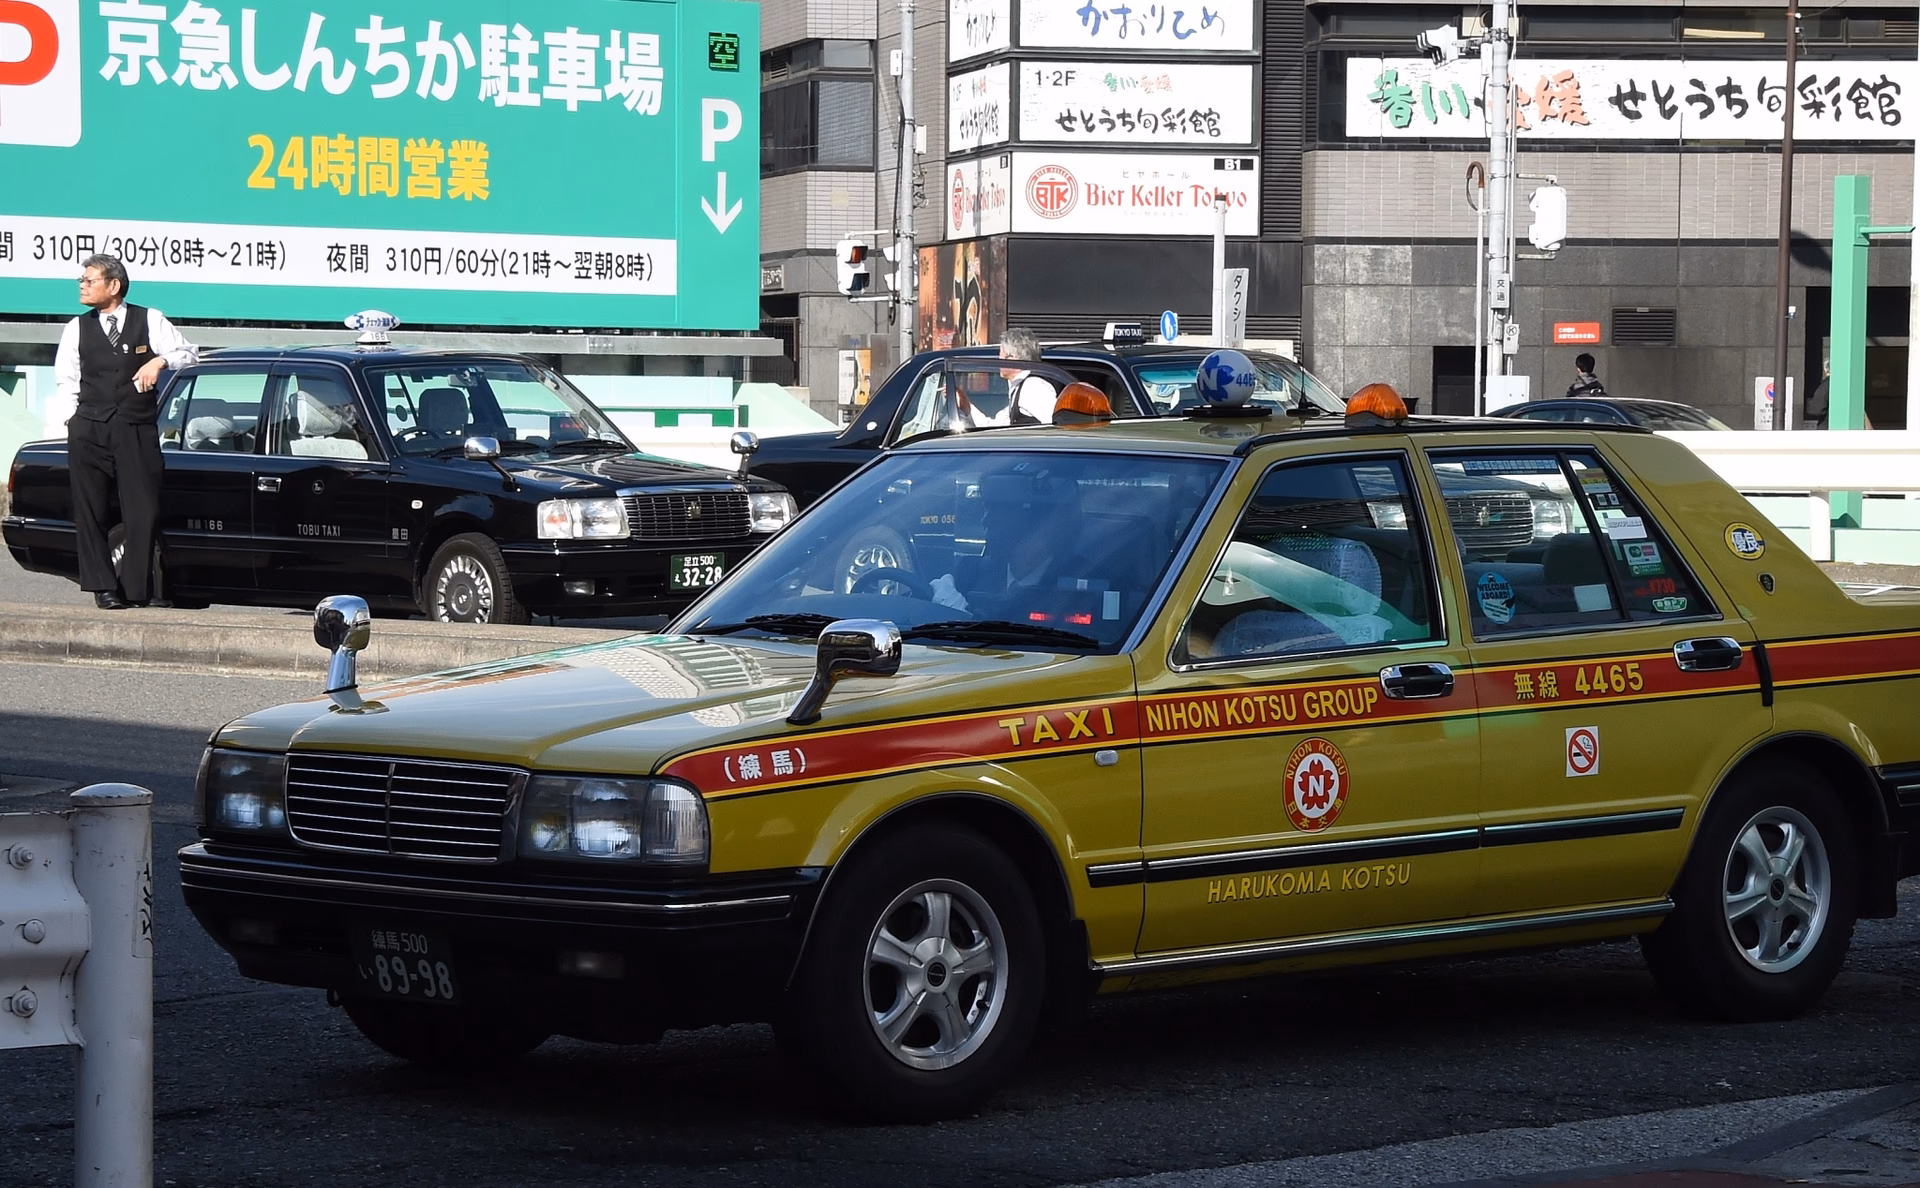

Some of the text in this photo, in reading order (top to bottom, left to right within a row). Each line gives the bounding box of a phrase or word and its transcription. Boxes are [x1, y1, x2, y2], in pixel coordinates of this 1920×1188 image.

[1077, 0, 1225, 40] かおりひめ
[99, 0, 664, 116] 京急しんちか駐車場
[709, 32, 739, 69] 空
[1608, 74, 1902, 126] せとうち旬彩館
[701, 97, 742, 162] P
[1055, 107, 1222, 137] せとうち旬彩館
[248, 133, 490, 201] 24時間営業
[1224, 159, 1241, 171] B1
[1036, 181, 1069, 210] BTK
[1085, 182, 1125, 207] Bier
[1131, 184, 1184, 208] Keller
[327, 243, 369, 274] 夜間
[1233, 275, 1243, 338] タクシー
[1114, 328, 1142, 337] TOKYO TAXI
[204, 519, 224, 531] 166
[297, 524, 341, 537] TOBU TAXI
[682, 566, 722, 587] 32-28
[1478, 582, 1511, 592] WELCOME
[1514, 662, 1644, 700] 無線 4465
[998, 706, 1115, 746] TAXI
[1144, 686, 1379, 733] NIHON KOTSU GROUP
[1286, 741, 1347, 780] NIHON KOTSU
[1308, 774, 1325, 797] N
[1207, 862, 1411, 904] HARUKOMA KOTSU
[371, 929, 428, 954] 練馬500
[375, 954, 454, 1000] 89-98
